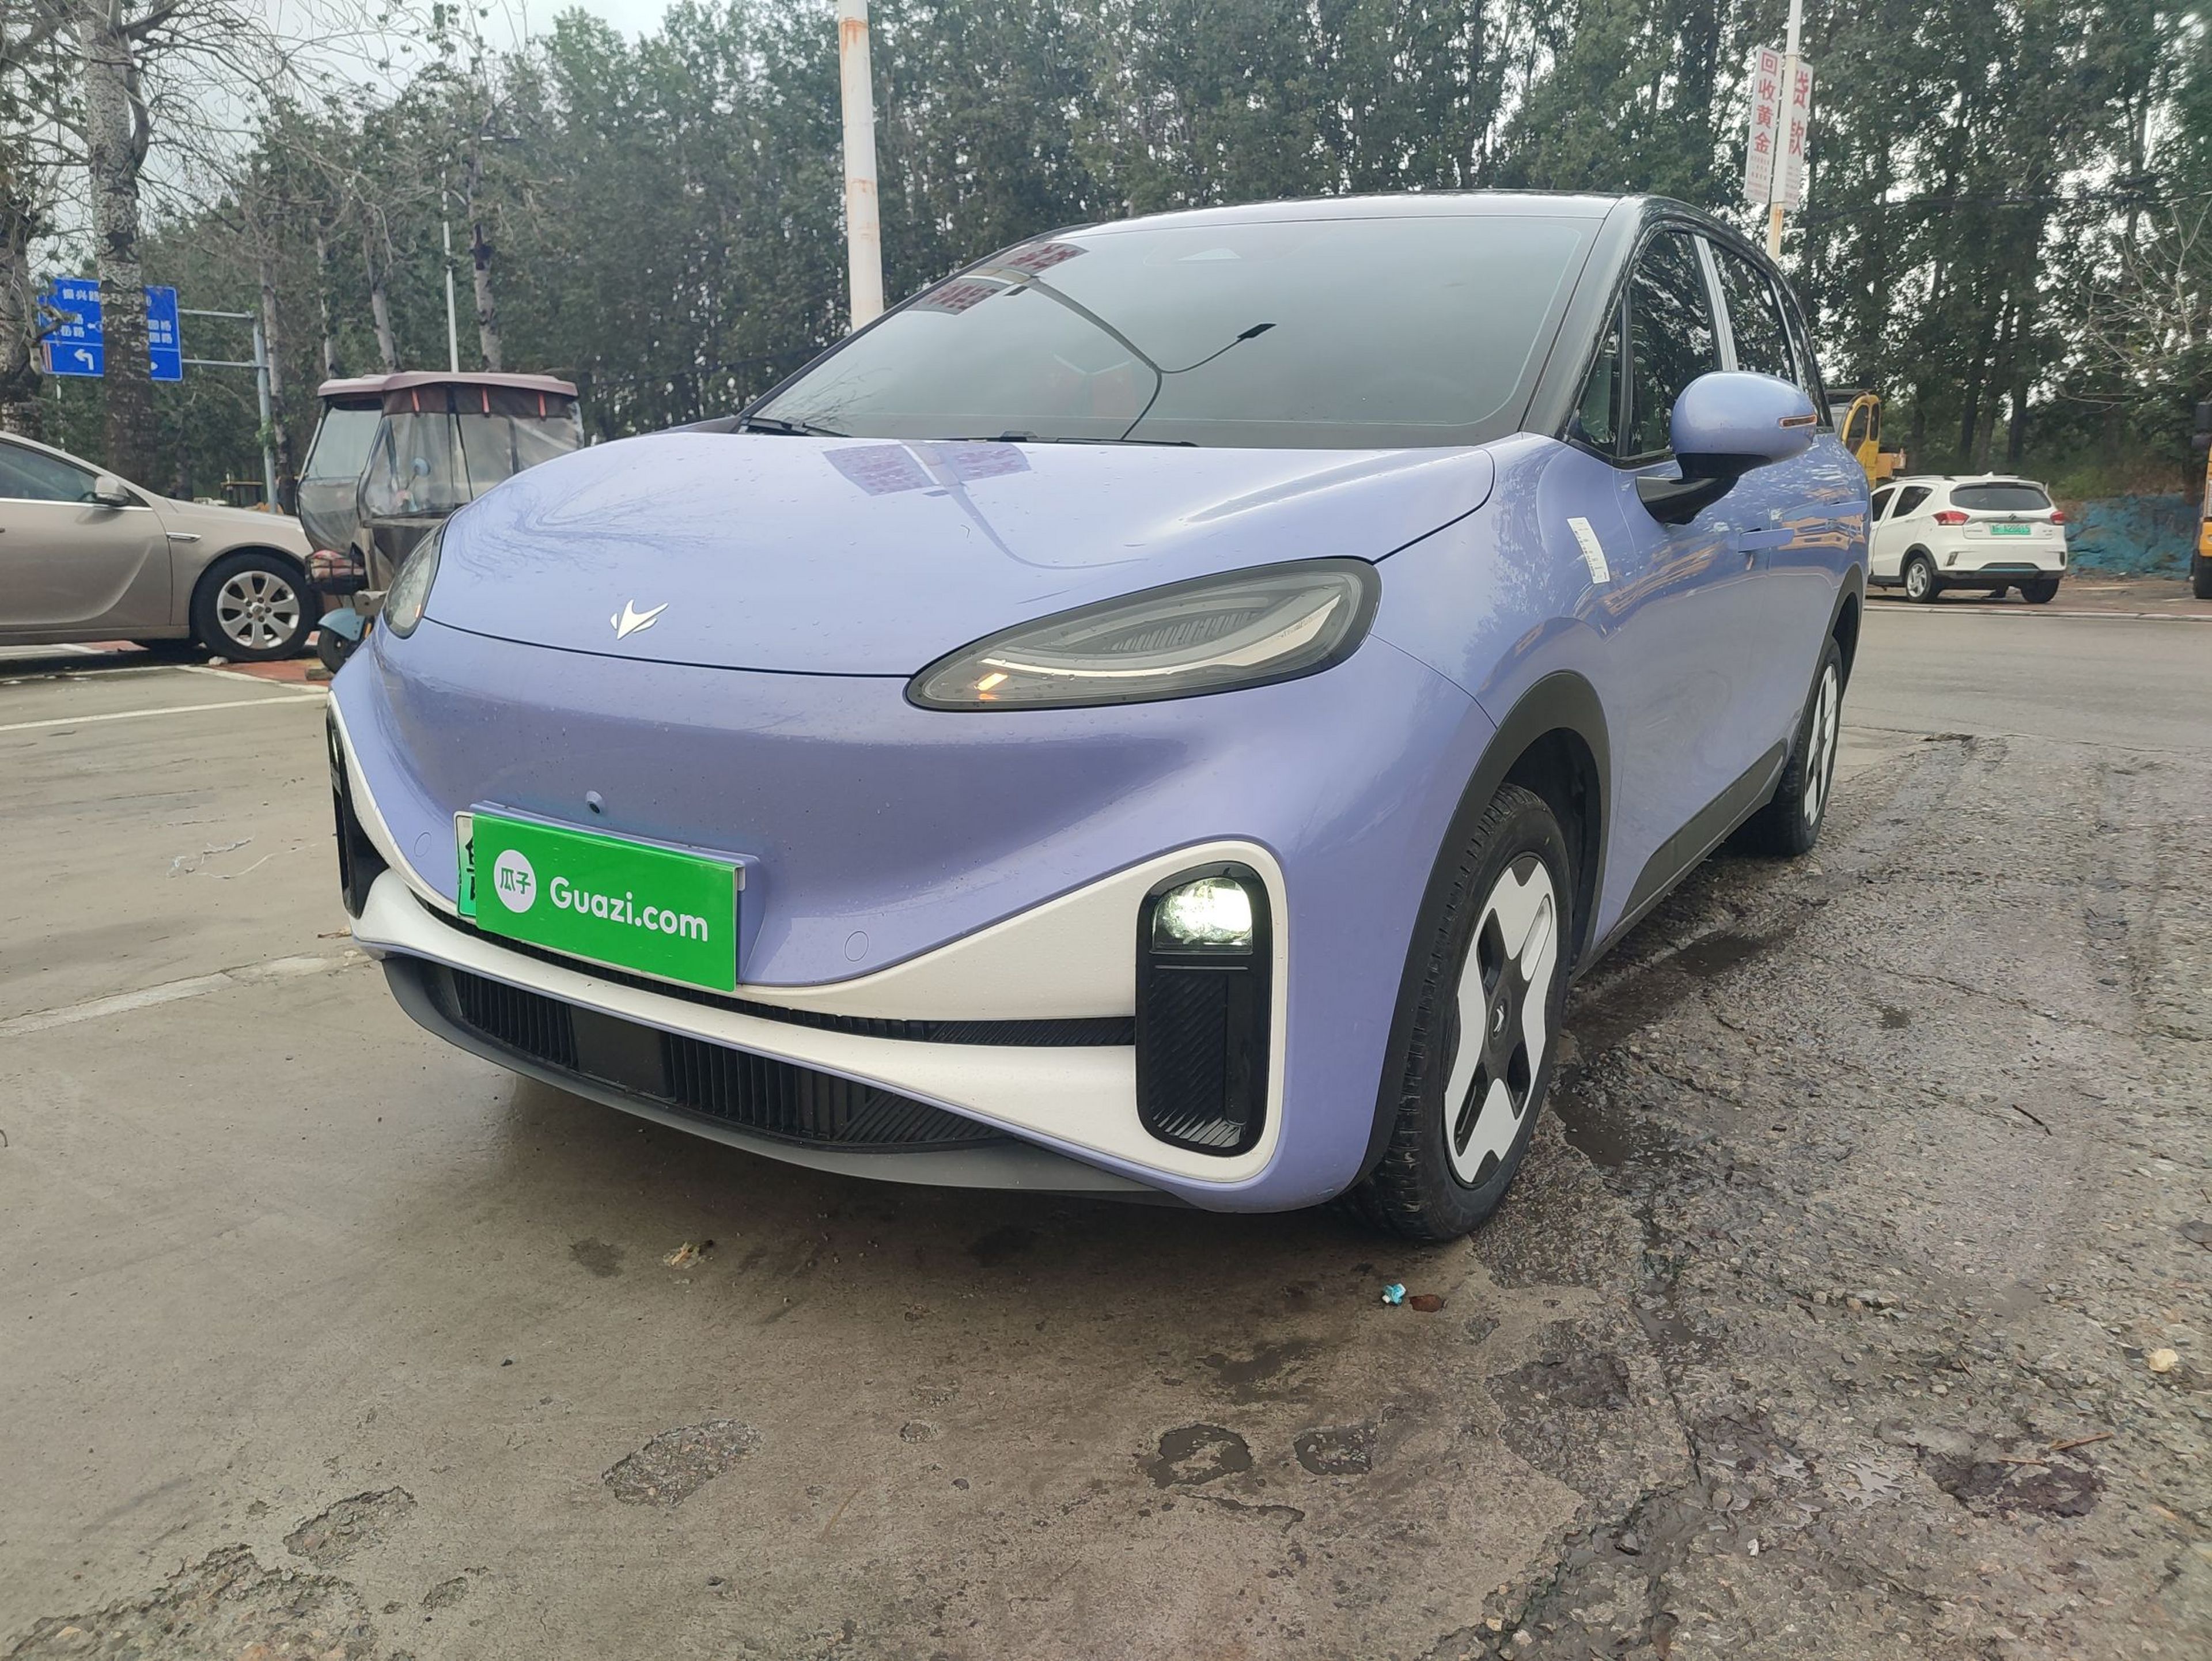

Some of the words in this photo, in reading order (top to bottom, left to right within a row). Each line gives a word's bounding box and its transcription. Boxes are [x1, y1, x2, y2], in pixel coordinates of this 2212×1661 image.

[1754, 52, 1778, 155] 回收黄金
[500, 867, 531, 894] 瓜子
[550, 876, 708, 942] Guazi.com
